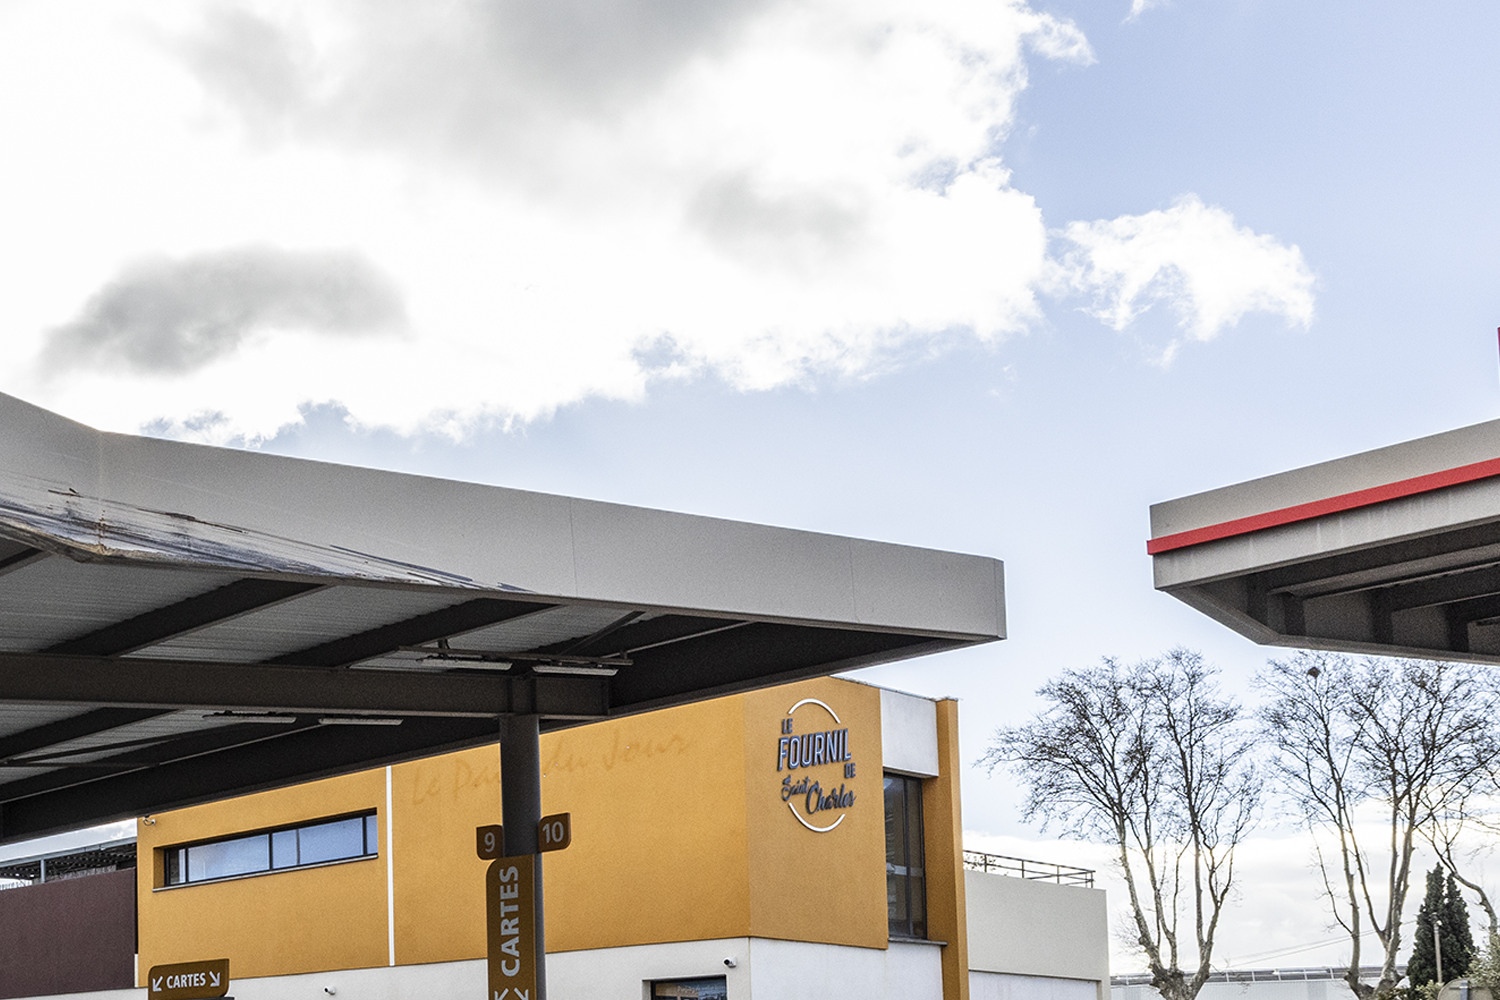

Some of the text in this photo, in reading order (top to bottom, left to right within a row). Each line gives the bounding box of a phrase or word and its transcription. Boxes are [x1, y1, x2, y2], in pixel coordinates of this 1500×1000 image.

[782, 718, 793, 735] LE
[777, 728, 852, 772] FOURNIL
[844, 762, 856, 778] DE
[782, 775, 857, 814] Saint Charles
[484, 832, 495, 853] 9
[542, 821, 564, 843] 10
[499, 865, 520, 977] CARTES
[166, 972, 206, 989] CARTES
